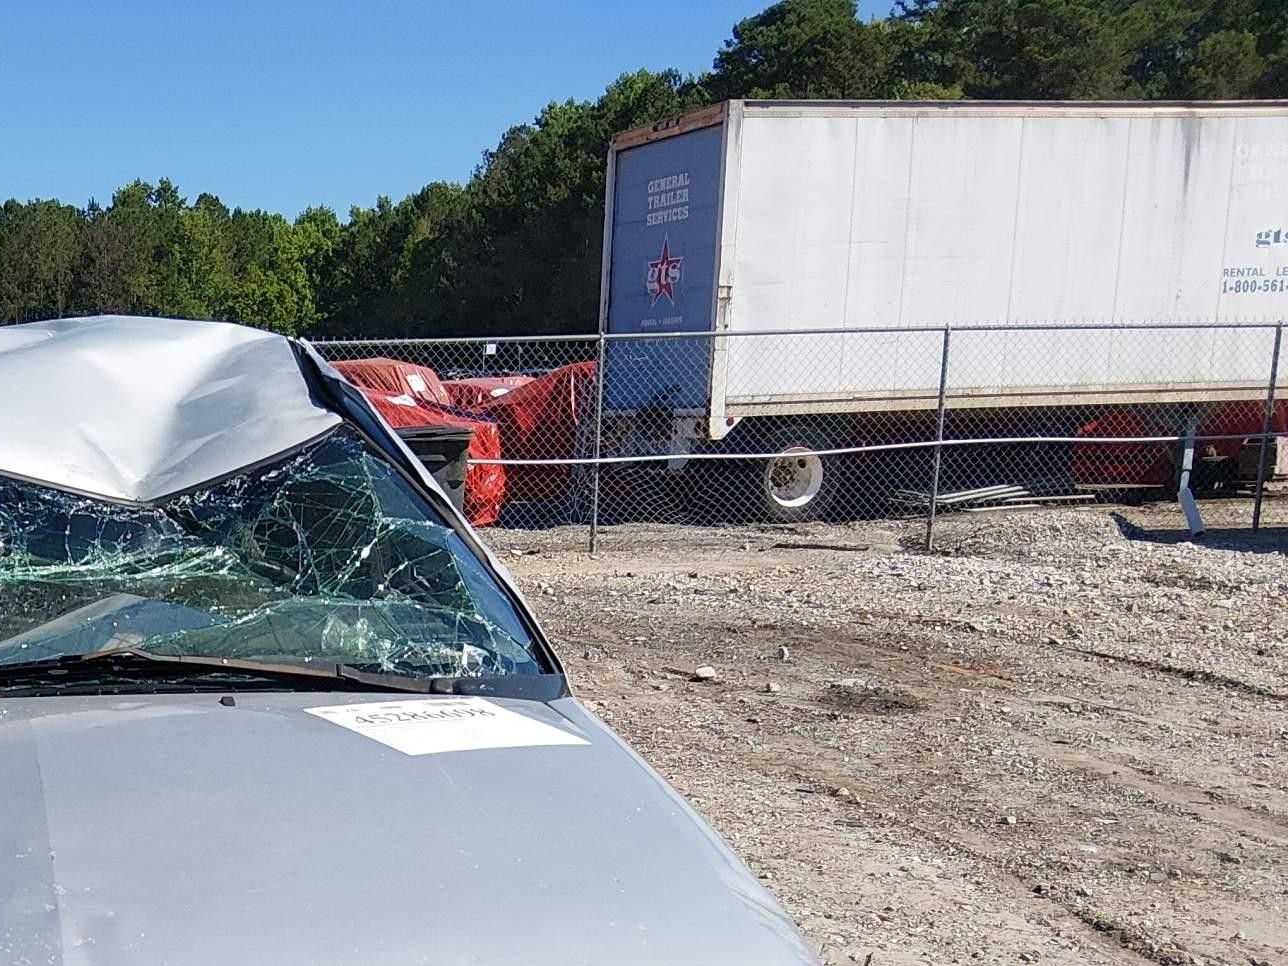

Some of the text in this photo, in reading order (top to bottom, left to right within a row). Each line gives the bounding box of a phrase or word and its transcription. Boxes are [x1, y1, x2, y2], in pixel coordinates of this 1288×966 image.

[647, 172, 690, 194] GENERAL
[647, 188, 689, 210] TRAILER
[646, 205, 689, 226] SERVICES
[646, 261, 680, 294] gts
[1222, 267, 1265, 278] RENTAL
[355, 707, 496, 725] 45286698
